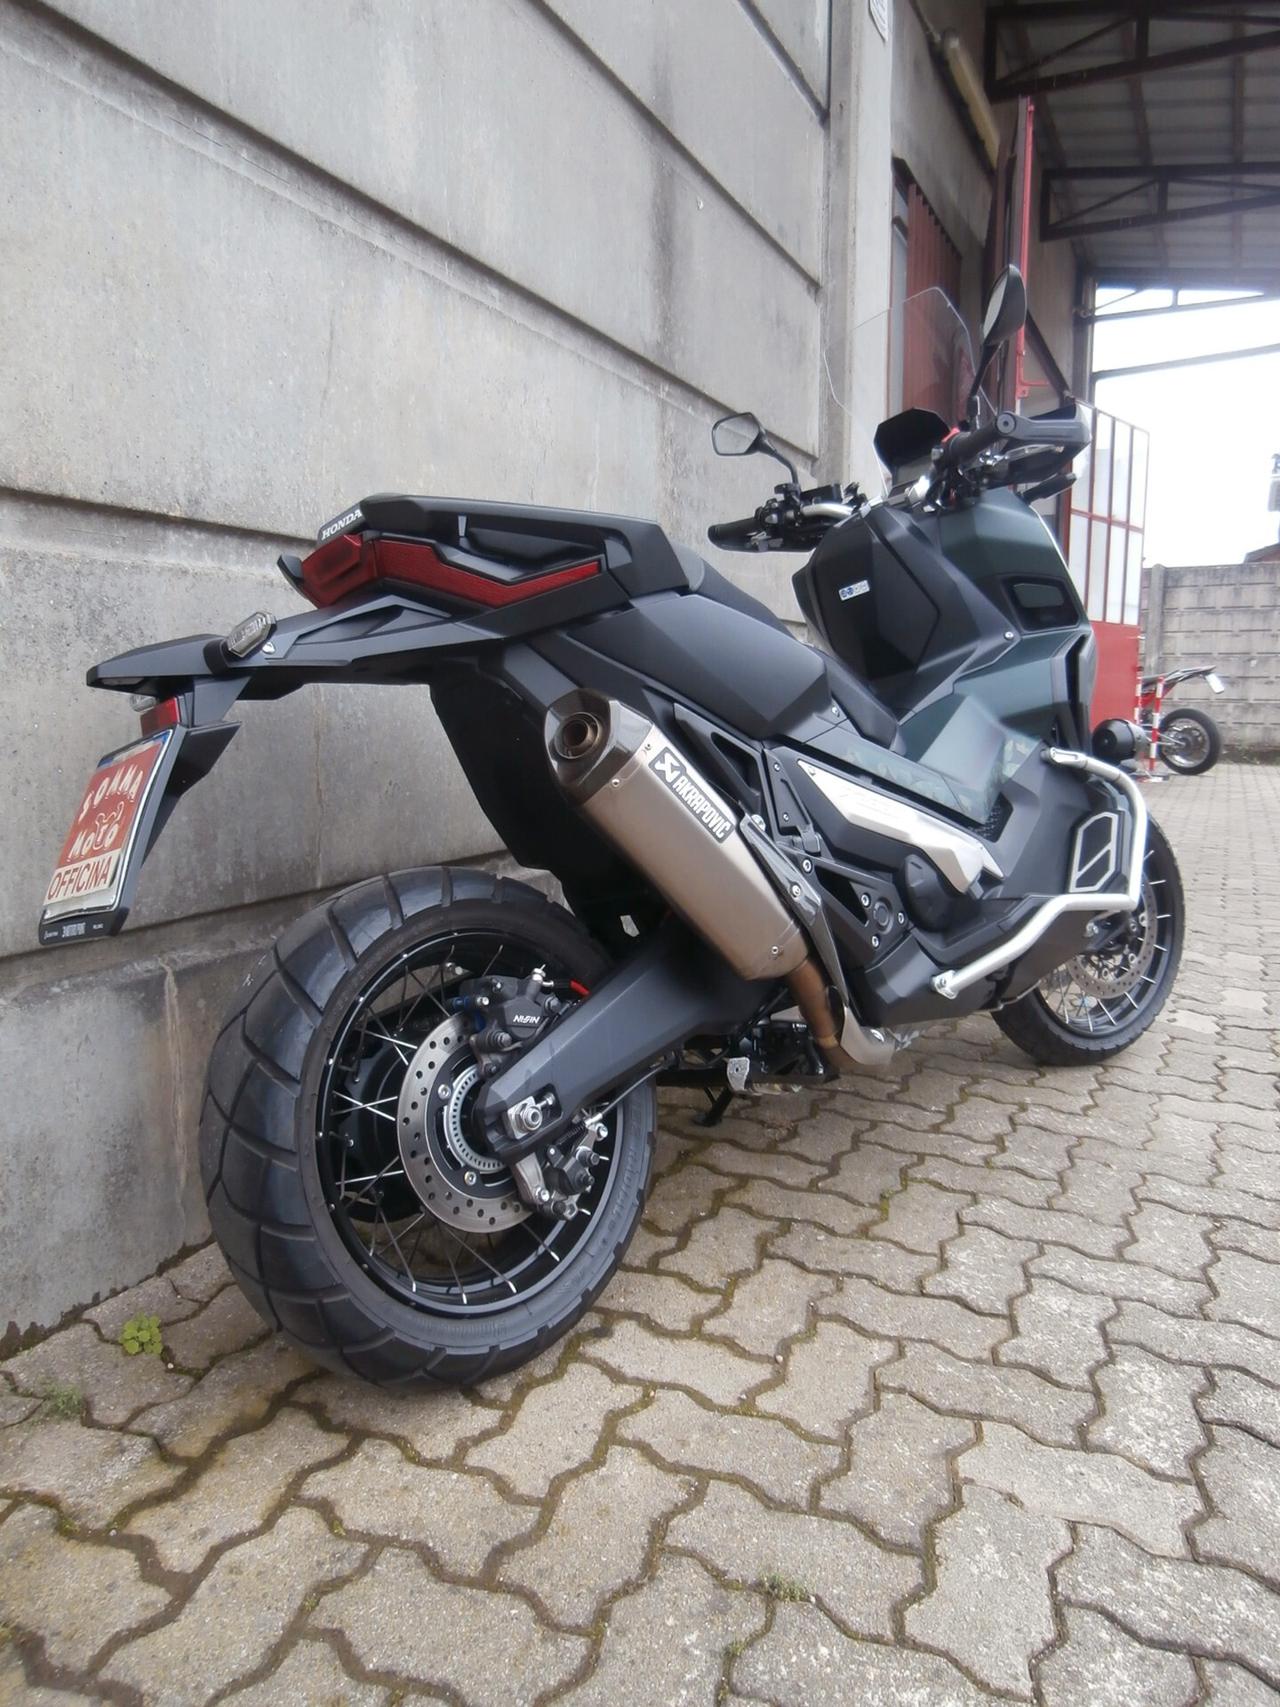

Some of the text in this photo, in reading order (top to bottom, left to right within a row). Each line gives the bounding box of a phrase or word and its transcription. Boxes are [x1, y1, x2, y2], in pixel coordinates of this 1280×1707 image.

[321, 509, 363, 541] HONDA
[78, 764, 144, 824] SOMMA
[672, 775, 732, 839] AKRAPOVIC
[66, 823, 120, 862] MOTO
[47, 856, 113, 900] OFFICINA
